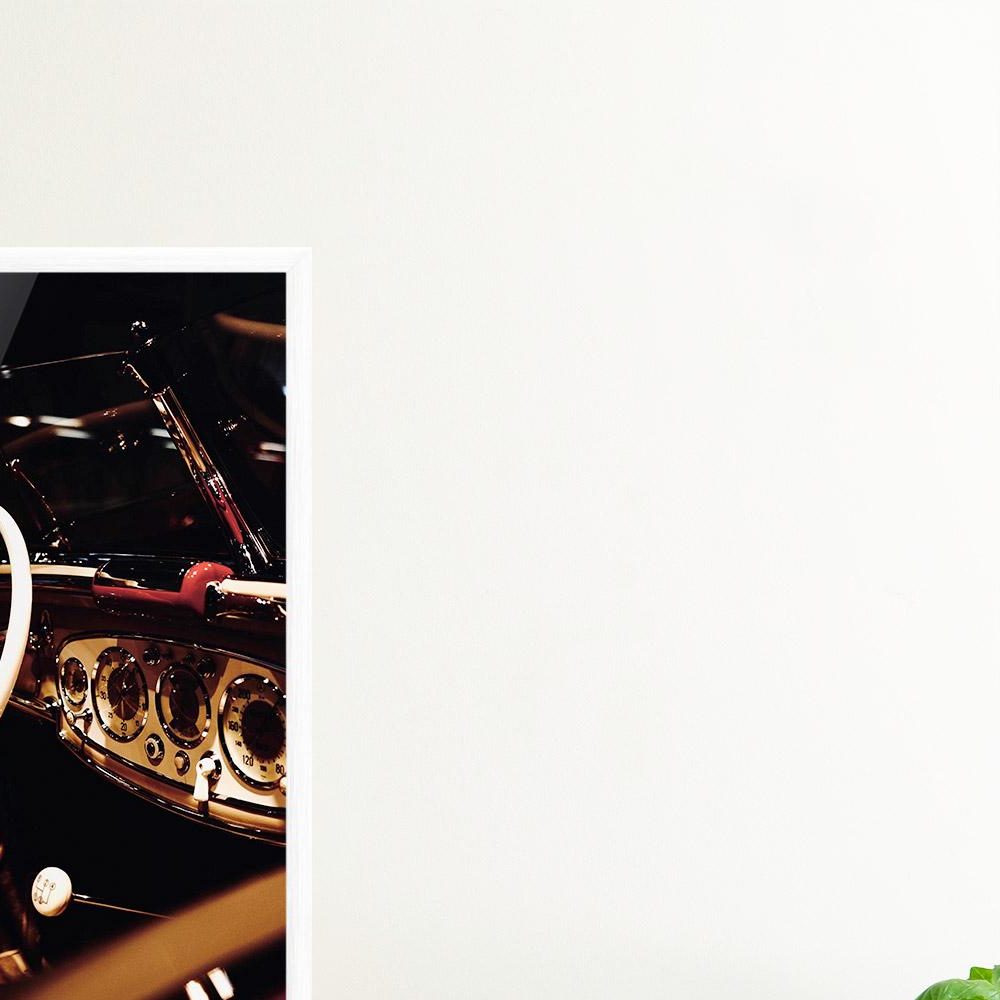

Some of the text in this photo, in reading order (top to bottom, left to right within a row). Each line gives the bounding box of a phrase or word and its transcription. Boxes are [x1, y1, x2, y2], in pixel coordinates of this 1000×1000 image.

[120, 722, 127, 731] 20
[242, 755, 253, 767] 120
[275, 763, 285, 774] 80
